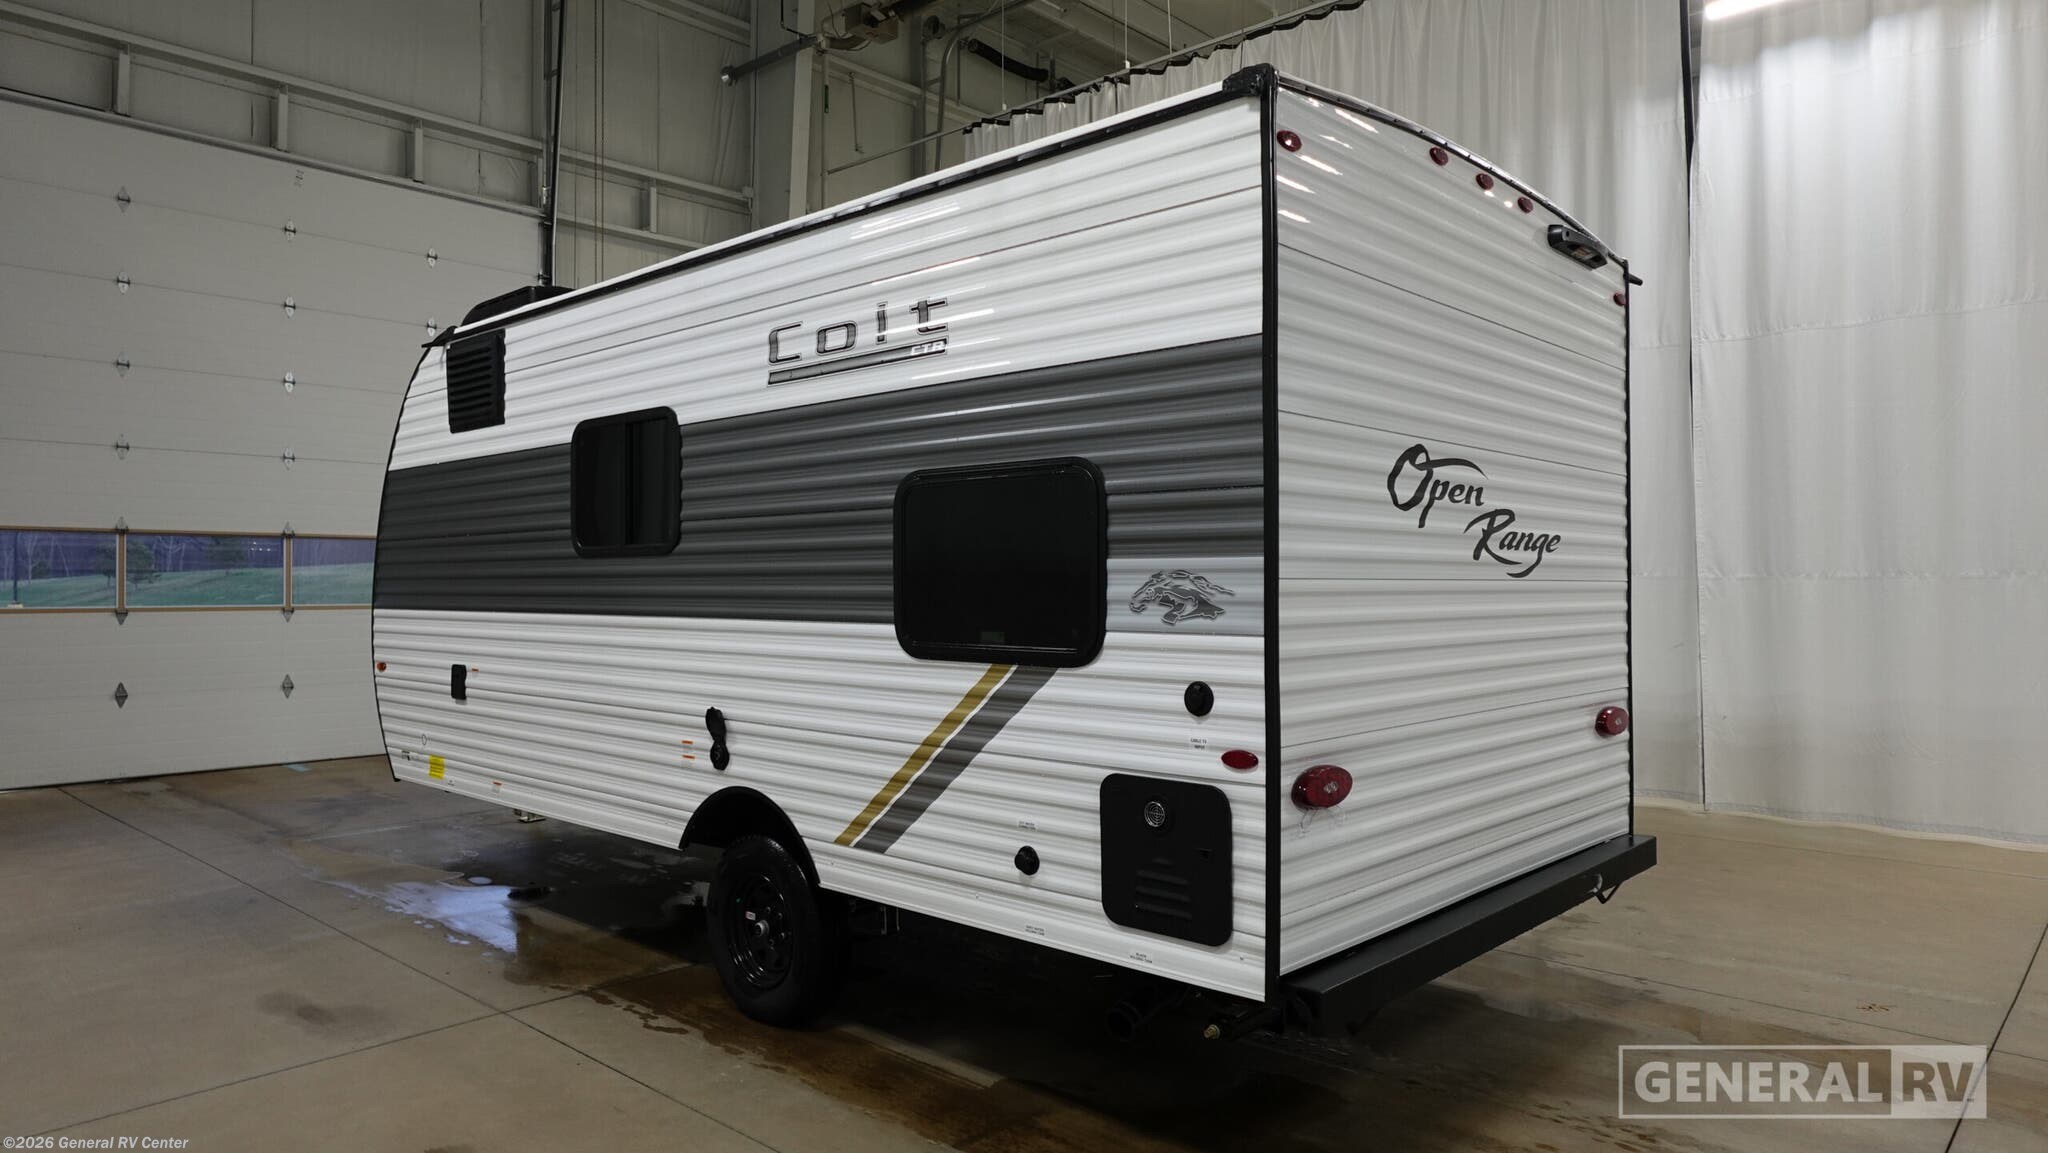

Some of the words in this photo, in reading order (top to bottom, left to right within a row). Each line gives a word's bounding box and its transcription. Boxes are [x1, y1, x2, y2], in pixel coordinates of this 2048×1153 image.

[768, 298, 948, 365] Colt
[1387, 443, 1489, 529] Open
[1463, 508, 1562, 578] Range
